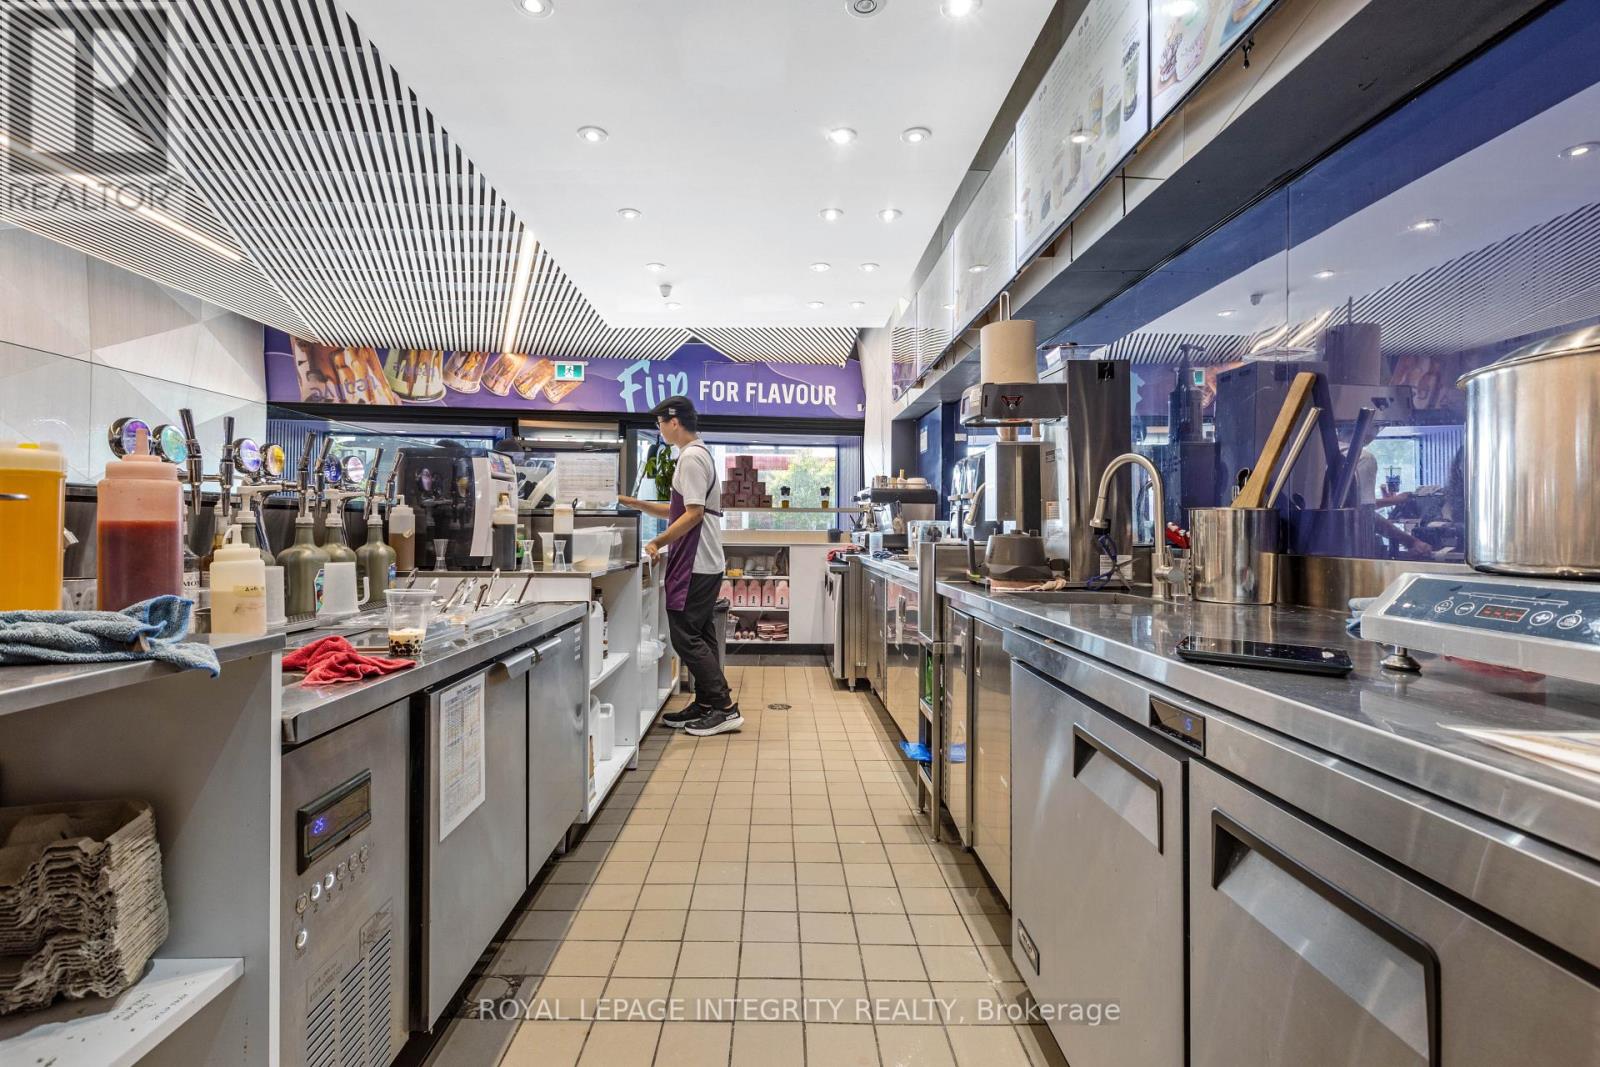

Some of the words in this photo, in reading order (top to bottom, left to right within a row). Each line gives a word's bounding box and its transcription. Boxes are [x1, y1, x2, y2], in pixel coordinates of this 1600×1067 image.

[617, 360, 688, 412] Flip
[700, 381, 738, 402] FOR
[746, 384, 837, 406] FLAVOUR
